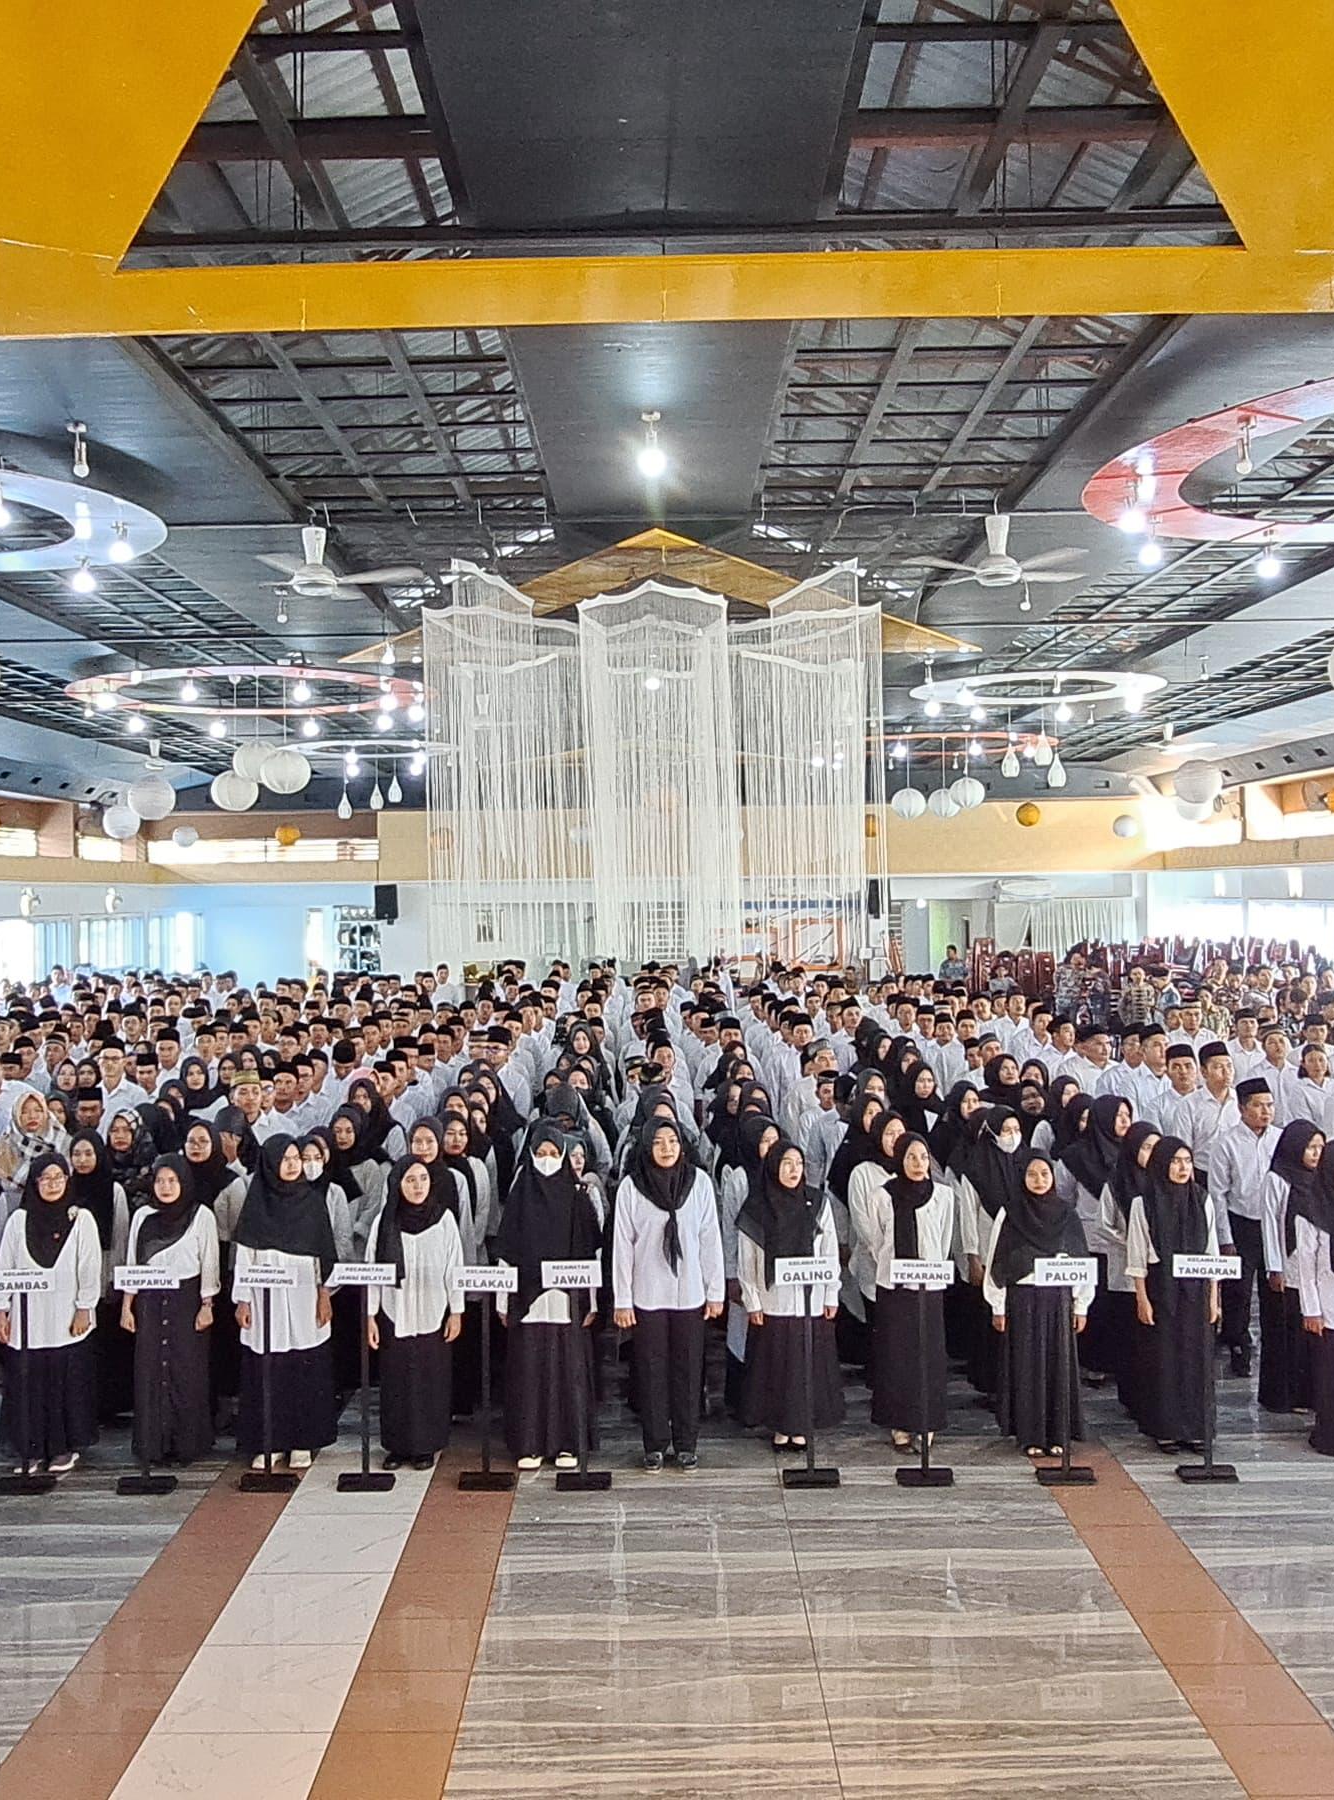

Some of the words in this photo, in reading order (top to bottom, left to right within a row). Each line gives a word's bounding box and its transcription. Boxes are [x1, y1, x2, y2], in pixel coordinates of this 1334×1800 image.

[1178, 1267, 1237, 1275] TANGARAN
[552, 1275, 591, 1284] JAWAI
[783, 1271, 833, 1281] GALING
[1045, 1272, 1087, 1281] PALOH
[120, 1278, 173, 1286] SEMPARUK
[239, 1277, 293, 1285] SEJANGKUNG
[457, 1279, 513, 1288] SELAKAU
